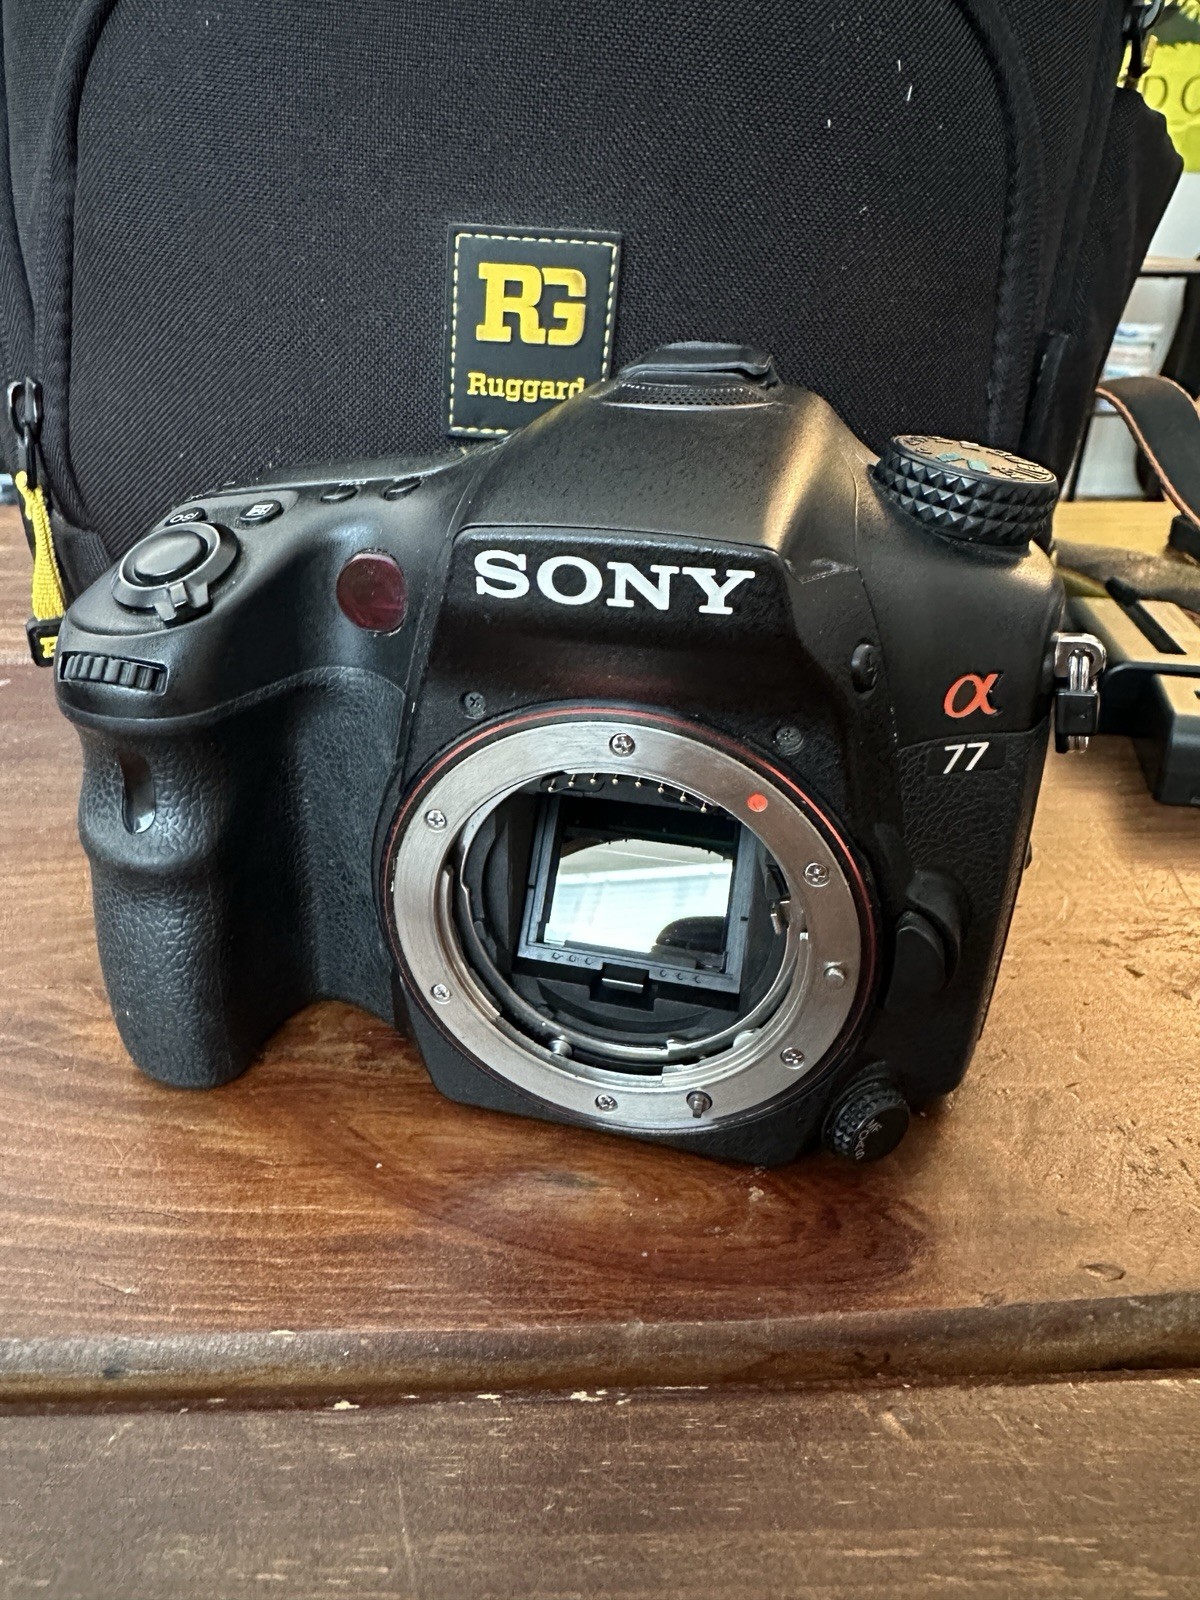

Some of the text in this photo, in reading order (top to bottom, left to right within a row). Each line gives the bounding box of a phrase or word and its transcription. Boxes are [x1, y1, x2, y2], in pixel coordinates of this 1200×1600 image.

[475, 262, 587, 346] RG
[466, 371, 585, 404] Ruggard
[473, 549, 756, 615] SONY
[943, 741, 990, 775] 77
